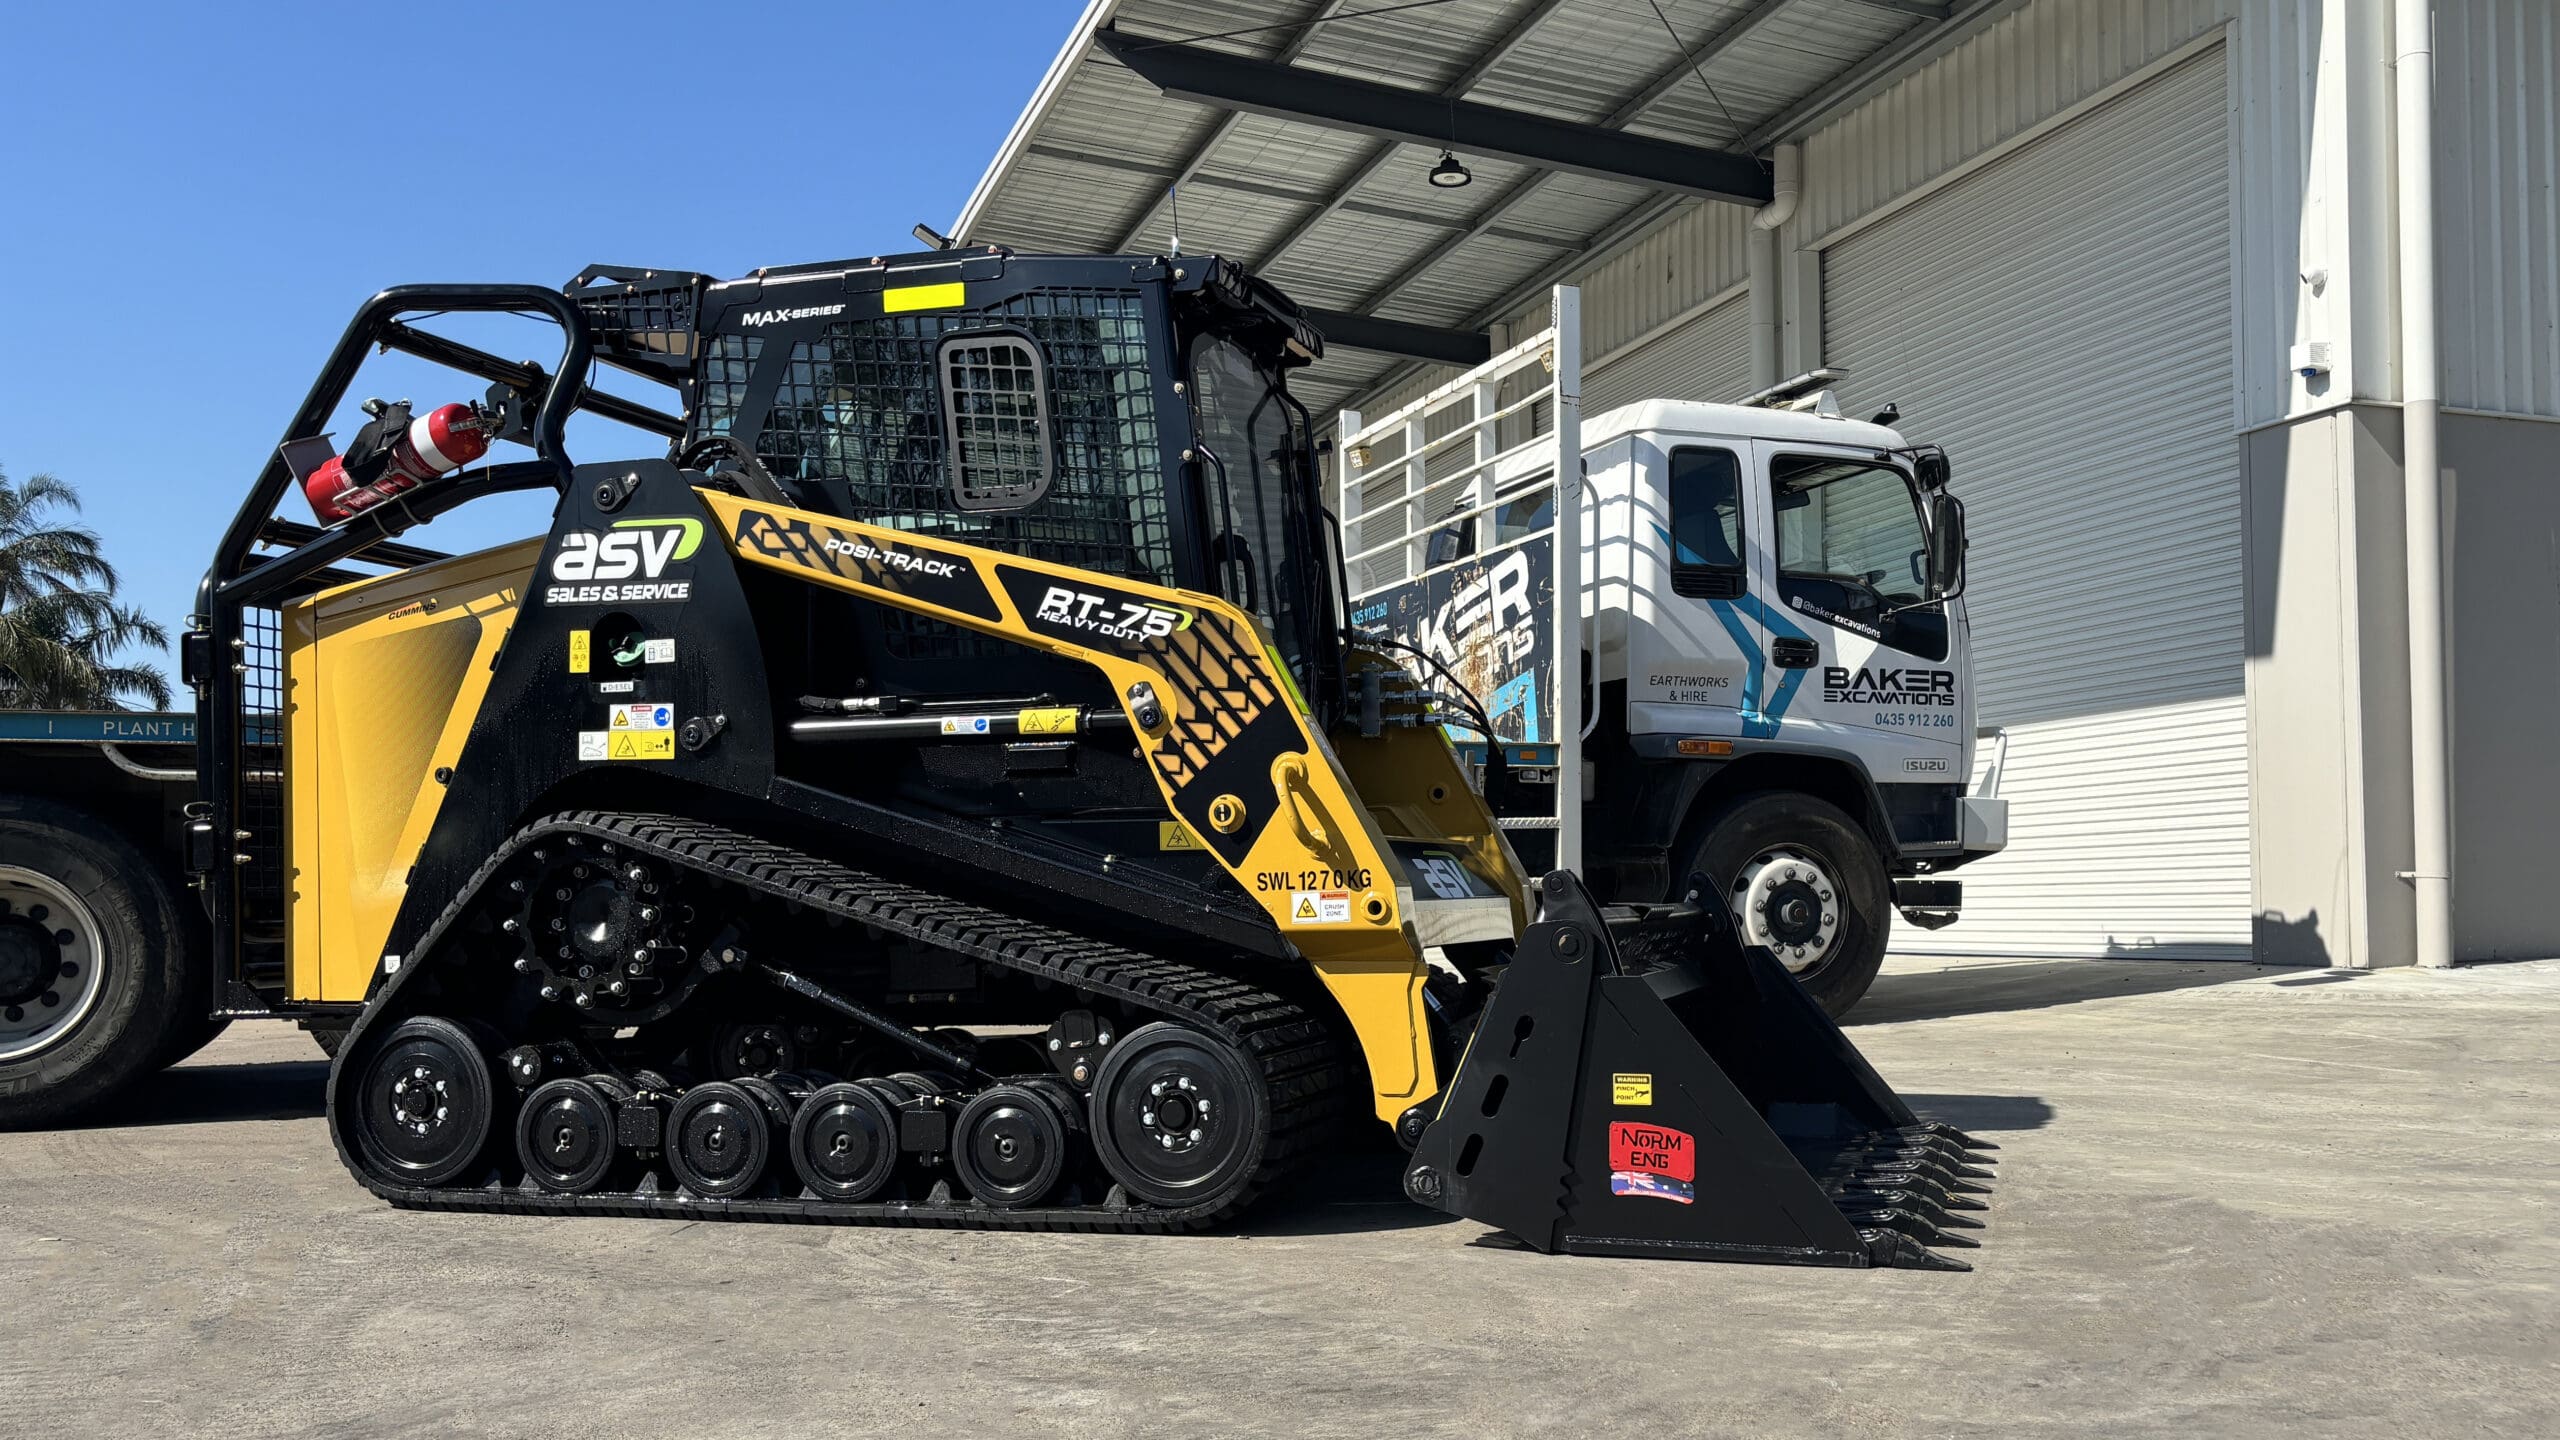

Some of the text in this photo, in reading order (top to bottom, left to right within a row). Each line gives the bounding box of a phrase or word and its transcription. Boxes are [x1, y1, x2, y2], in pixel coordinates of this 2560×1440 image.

[824, 538, 957, 578] POSI-TRACK
[602, 585, 619, 602] &
[620, 583, 689, 601] SERVICE
[388, 602, 438, 620] CUMMINS
[1036, 586, 1176, 637] RT-75
[1364, 605, 1376, 622] 912
[1376, 602, 1388, 618] 260
[1395, 550, 1532, 682] AKER
[1803, 600, 1881, 638] @baker.excavations
[1036, 610, 1151, 643] HEAVY DUTY
[607, 683, 632, 692] DIESEL
[1649, 675, 1729, 688] EARTHWORKS
[1824, 666, 1955, 693] BAKER
[1669, 690, 1708, 702] & HIRE
[1824, 690, 1955, 706] EXCAVATIONS
[103, 720, 173, 736] PLANT
[1875, 712, 1954, 728] 0435 912 260
[1906, 760, 1946, 771] ISUZU
[1257, 868, 1372, 892] SWL 1270 KG
[1631, 1151, 1669, 1169] ENG
